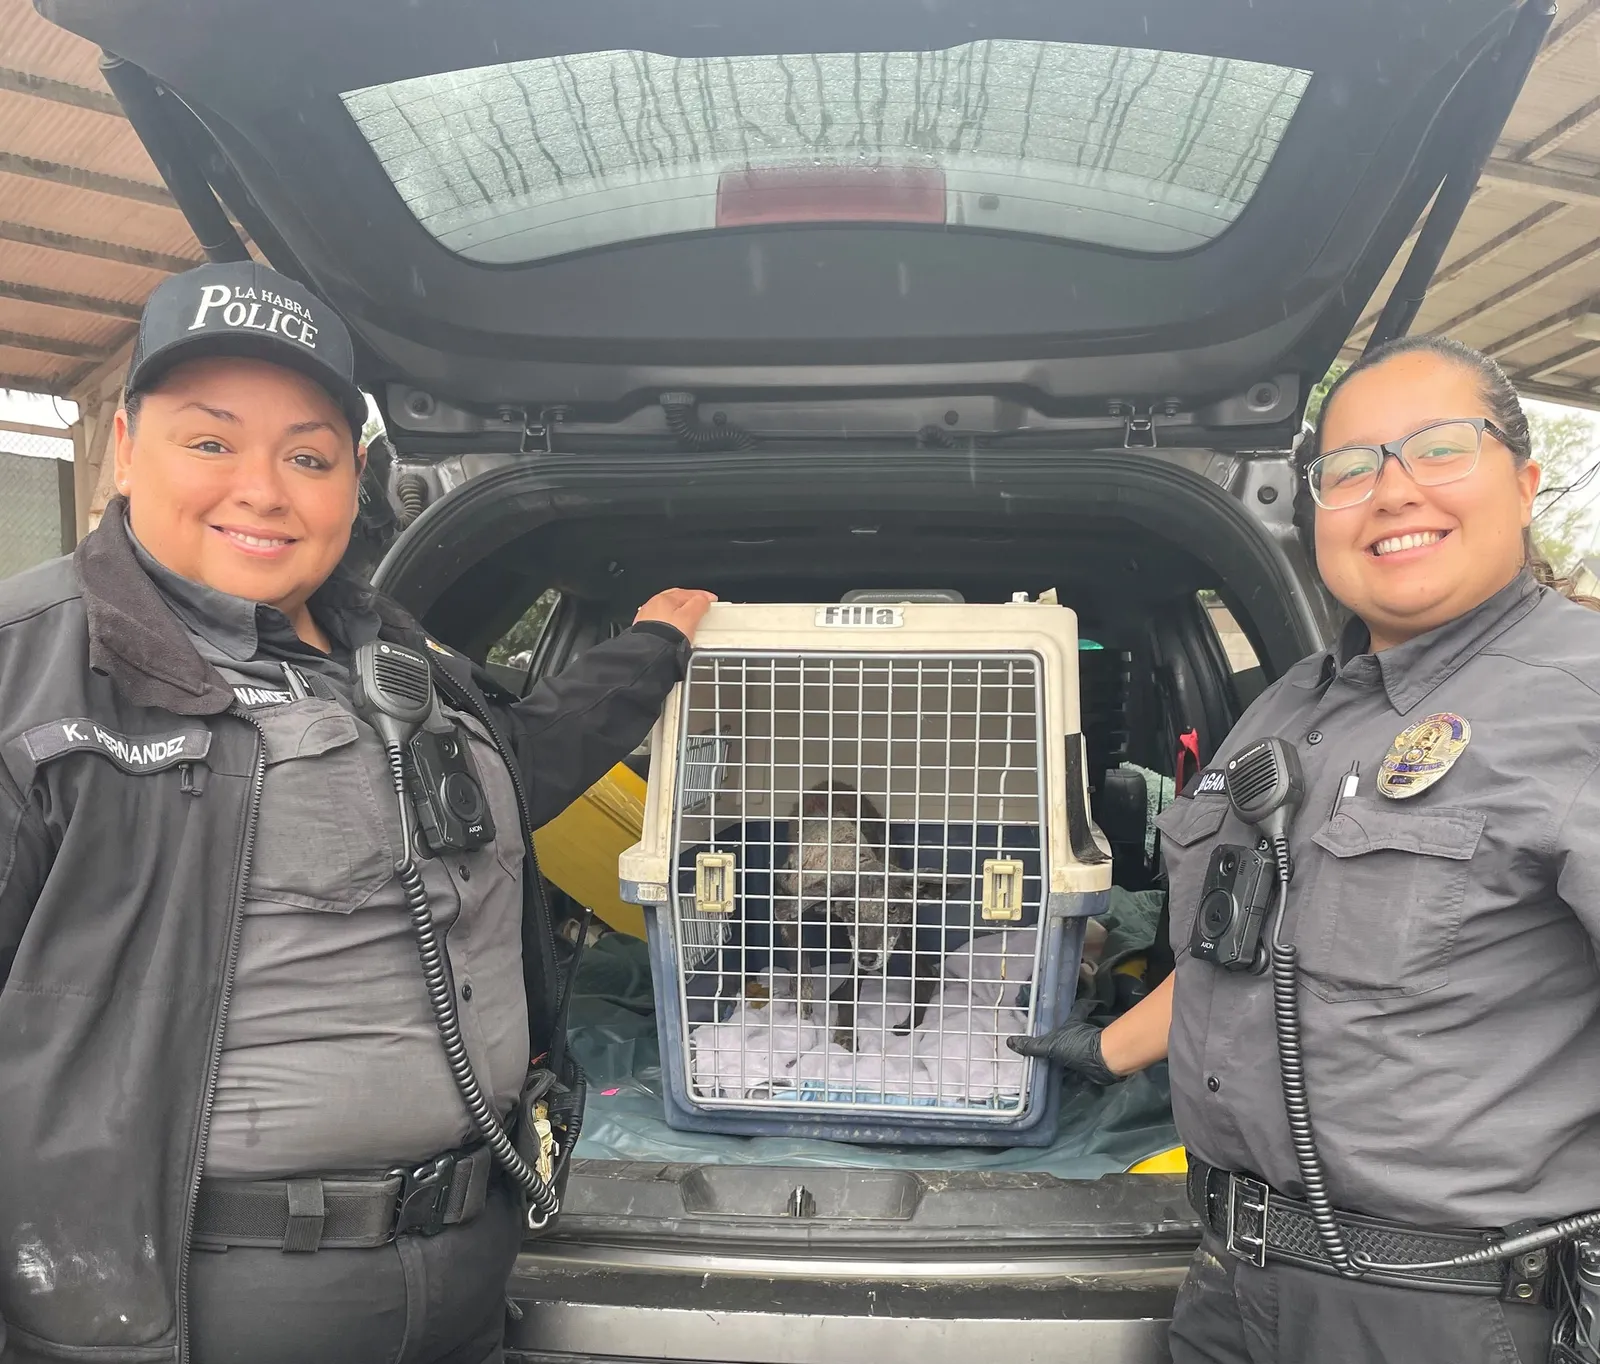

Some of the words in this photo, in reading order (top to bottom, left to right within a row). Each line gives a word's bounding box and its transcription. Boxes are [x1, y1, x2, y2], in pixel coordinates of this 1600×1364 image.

[187, 284, 319, 349] POLICE
[235, 286, 257, 300] LA
[261, 289, 314, 323] HABRA
[62, 723, 90, 742] K.
[93, 725, 186, 765] HERNANDEZ
[468, 824, 483, 834] AXON
[1200, 941, 1215, 950] AXON
